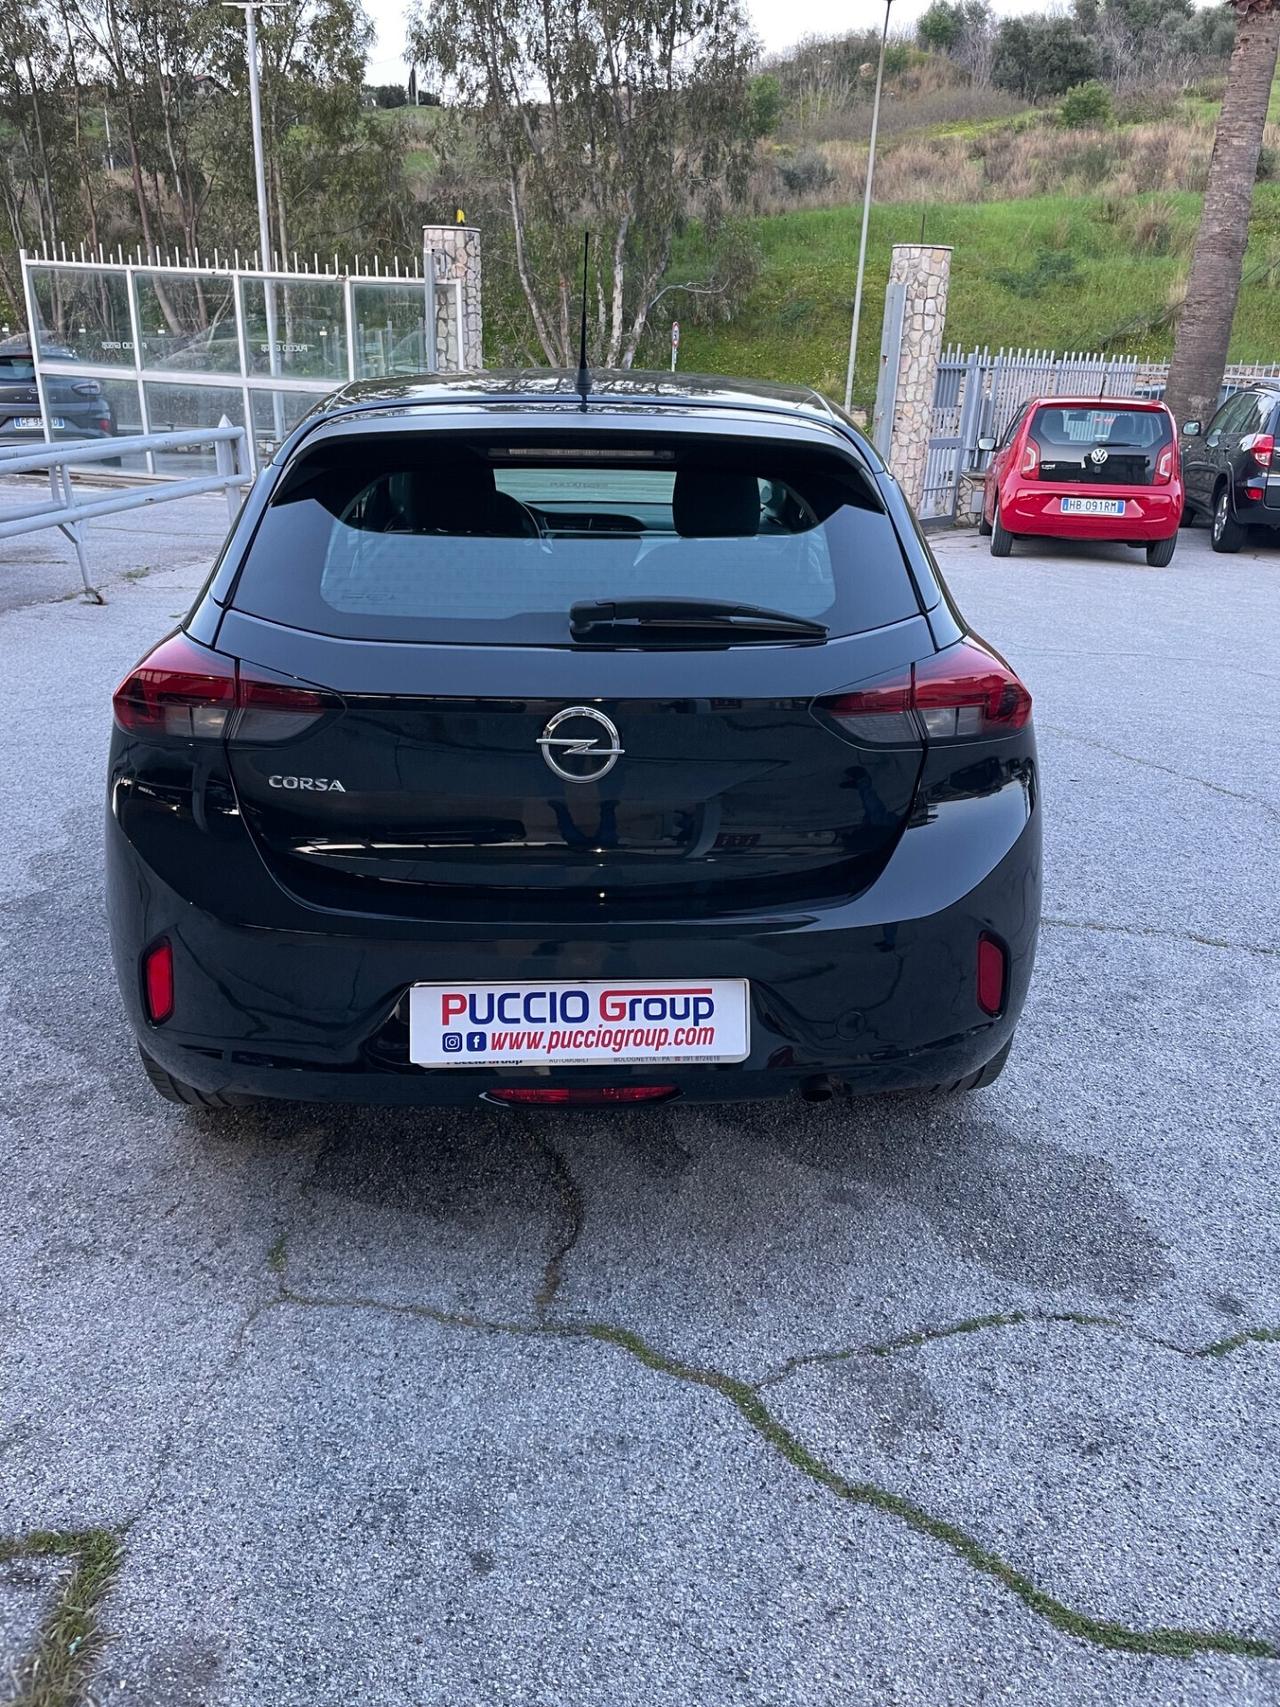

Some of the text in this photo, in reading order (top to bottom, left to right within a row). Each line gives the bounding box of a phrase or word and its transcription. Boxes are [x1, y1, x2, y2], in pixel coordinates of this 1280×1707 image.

[1069, 500, 1117, 511] HB 091RM
[268, 775, 346, 793] CORSA
[442, 988, 715, 1026] PUCCIO Group
[491, 1024, 715, 1055] www.pucciogroup.com
